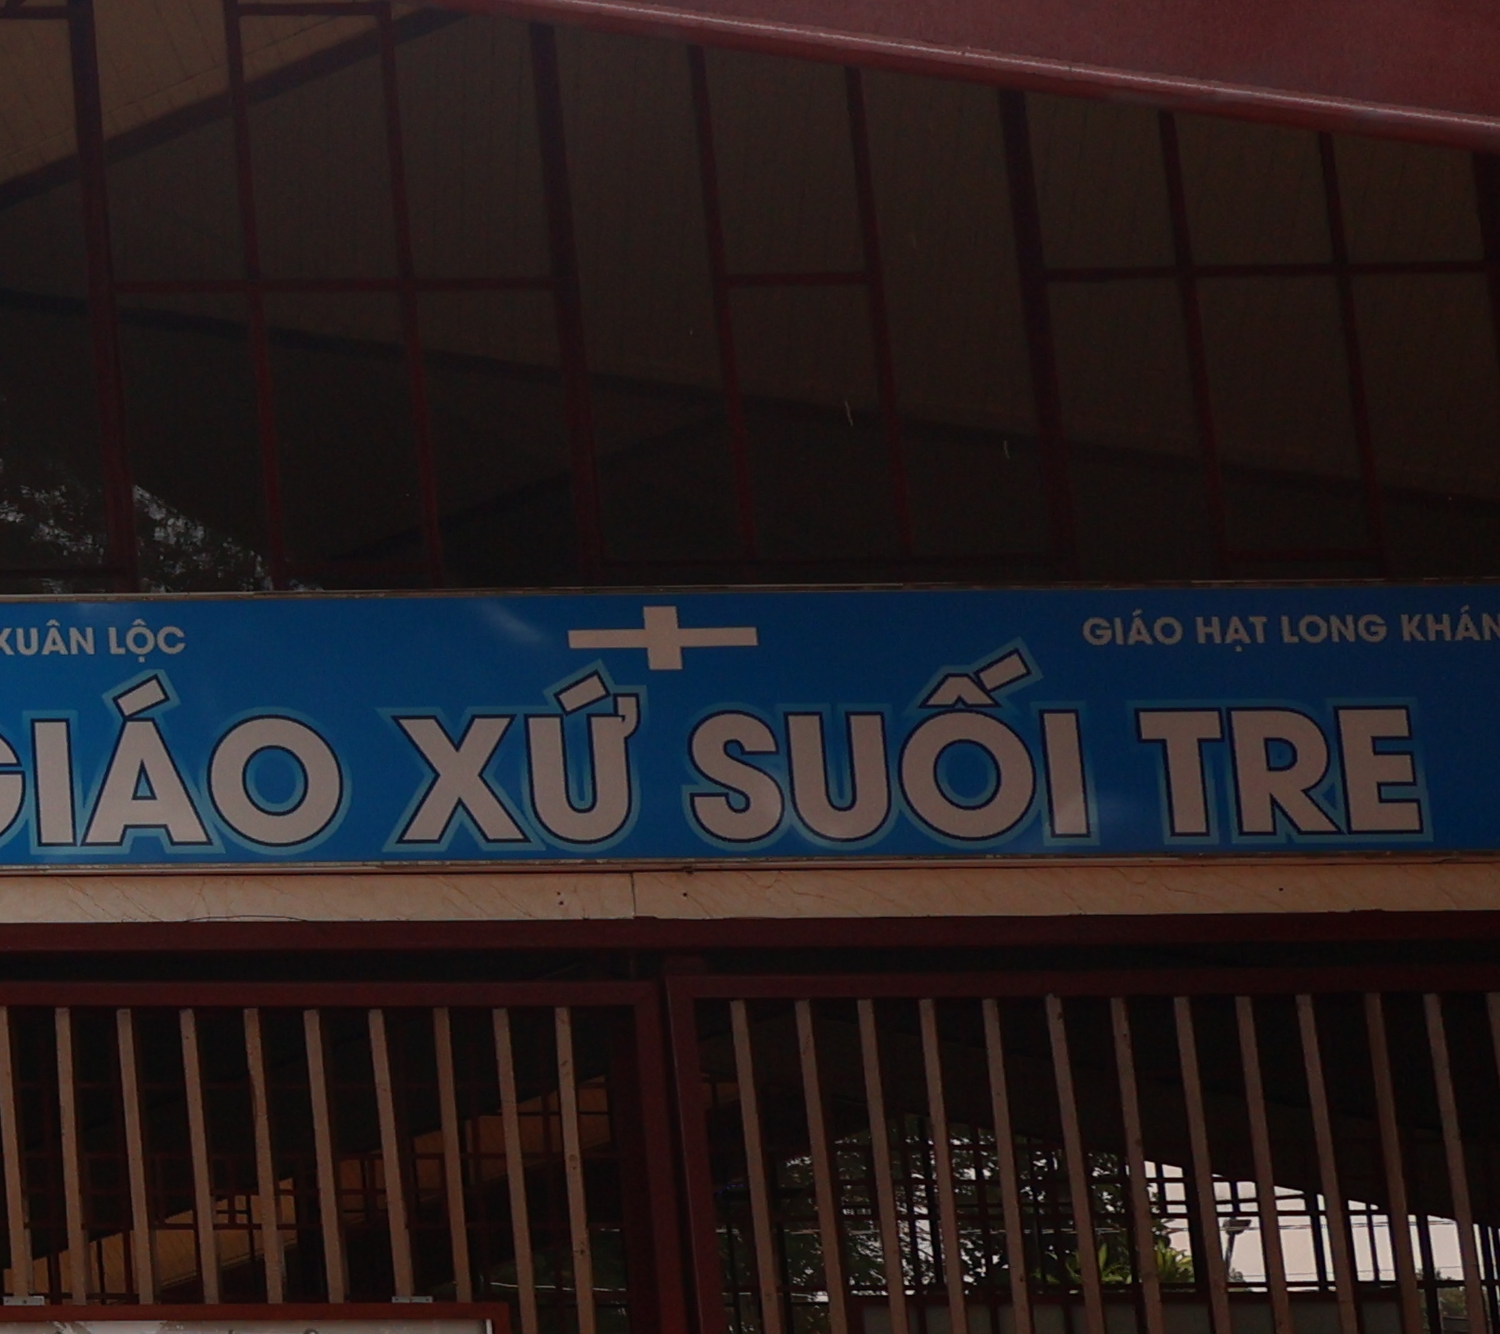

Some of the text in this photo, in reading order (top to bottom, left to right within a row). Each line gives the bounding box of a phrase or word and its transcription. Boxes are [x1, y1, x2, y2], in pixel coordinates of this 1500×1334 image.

[108, 618, 187, 664] LỘC
[1082, 609, 1184, 646] GIÁO
[1195, 615, 1268, 653] HẠT
[1280, 614, 1388, 644] LONG
[391, 669, 641, 846] XỨ
[688, 648, 1093, 844] SUỐI
[1135, 704, 1425, 837] TRE
